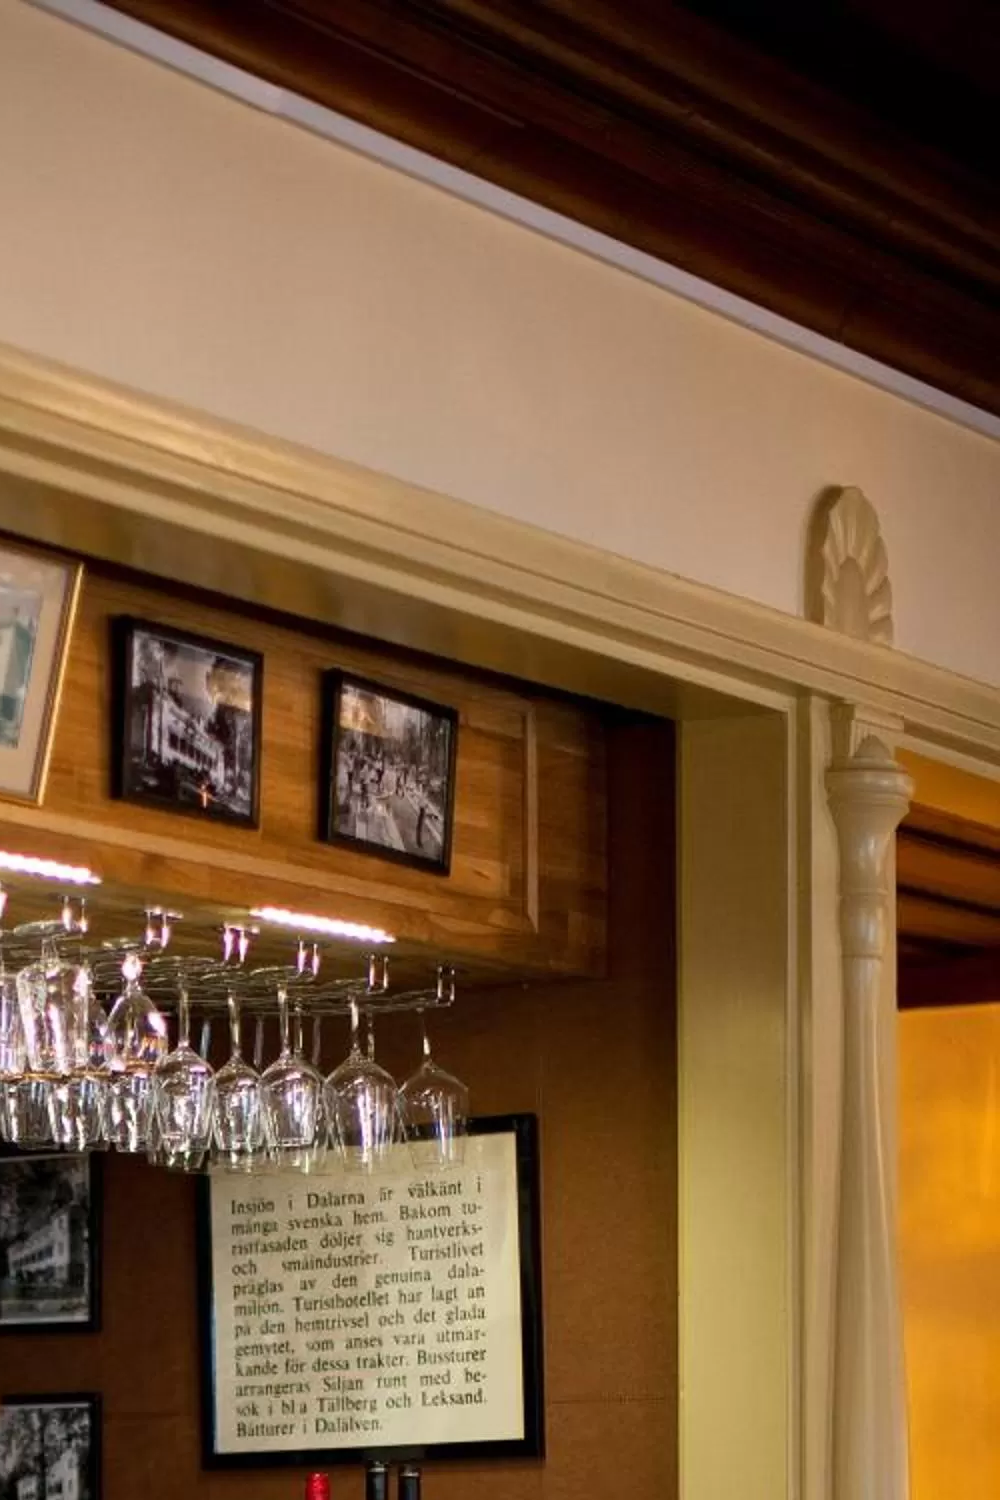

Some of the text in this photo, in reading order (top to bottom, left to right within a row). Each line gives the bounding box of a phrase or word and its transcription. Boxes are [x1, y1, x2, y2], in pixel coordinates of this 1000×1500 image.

[307, 1191, 365, 1209] Dalarna
[288, 1212, 343, 1230] svenska
[400, 1204, 451, 1220] Bakom
[375, 1228, 394, 1246] sig
[231, 1259, 257, 1276] och
[408, 1242, 483, 1261] Turistlivet
[300, 1279, 317, 1290] av
[331, 1273, 357, 1288] den
[375, 1267, 431, 1288] genuina
[292, 1291, 389, 1312] Turisthotellet
[398, 1287, 422, 1304] har
[431, 1285, 457, 1304] lagt
[260, 1319, 285, 1335] den
[295, 1311, 369, 1333] hemtrivsel
[377, 1308, 405, 1327] och
[413, 1307, 436, 1324] det
[445, 1303, 486, 1325] glada
[306, 1338, 334, 1352] som
[346, 1335, 383, 1350] anses
[393, 1332, 425, 1345] vara
[235, 1360, 278, 1377] kande
[285, 1357, 306, 1374] för
[312, 1356, 349, 1373] dessa
[417, 1348, 487, 1366] Bussturer
[235, 1381, 310, 1399] arrangeras
[323, 1375, 363, 1394] Siljan
[376, 1375, 407, 1388] runt
[420, 1368, 451, 1386] med
[385, 1391, 411, 1408] och
